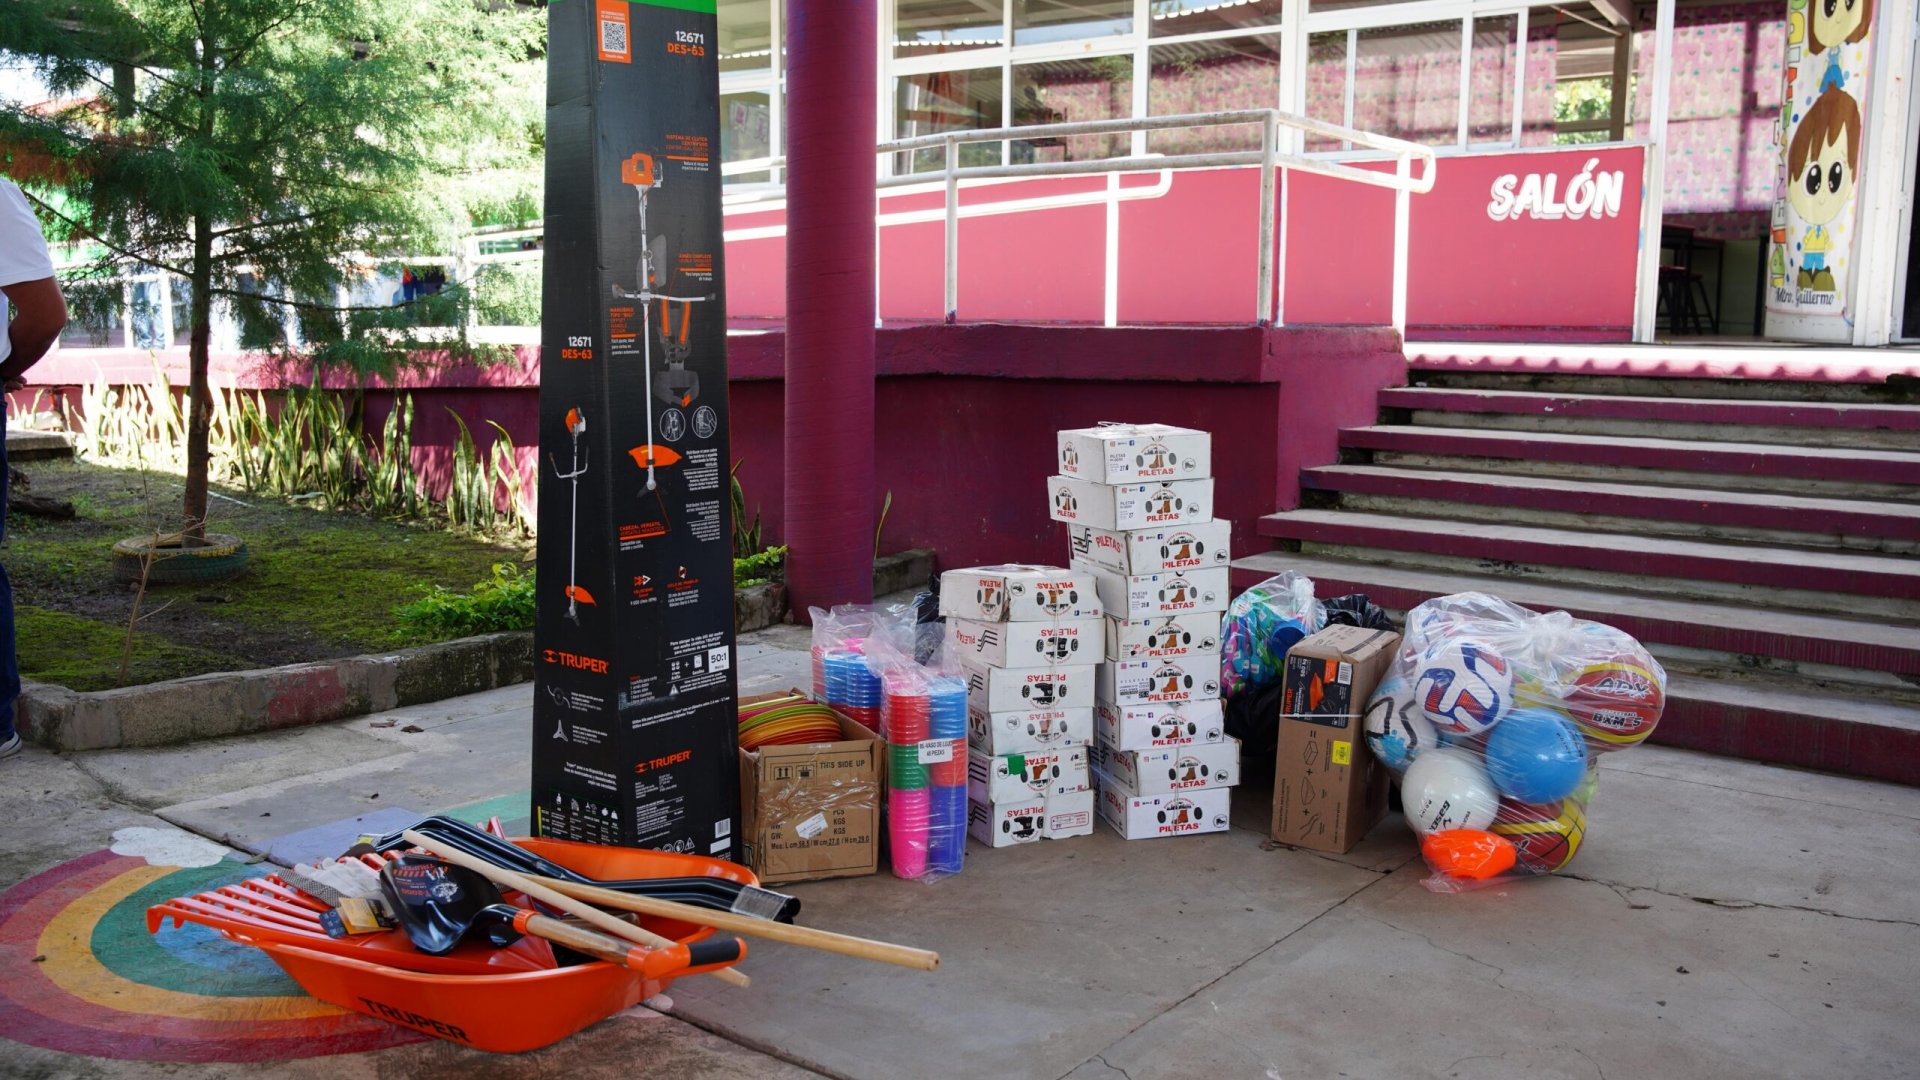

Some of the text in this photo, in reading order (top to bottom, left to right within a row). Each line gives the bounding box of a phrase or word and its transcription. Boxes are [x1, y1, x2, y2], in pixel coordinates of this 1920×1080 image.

[675, 30, 704, 45] 12671
[667, 43, 705, 57] DES-63
[1487, 157, 1624, 222] SALÓN
[1796, 287, 1835, 308] Guillermo
[568, 336, 592, 347] 12671
[562, 349, 592, 360] DES-63
[1138, 467, 1174, 477] PILETAS
[1057, 509, 1077, 519] PILETAS
[1146, 513, 1180, 522] PILETAS
[1095, 535, 1121, 553] PILETAS
[980, 579, 1002, 588] PILETAS
[1160, 601, 1195, 611] PILETAS
[956, 629, 976, 645] PILETAS
[559, 652, 608, 675] TRUPER
[711, 652, 727, 664] 50:1
[1148, 691, 1190, 702] PILETAS
[1029, 712, 1065, 720] PILETAS
[1151, 737, 1192, 746] PILETAS
[649, 750, 693, 770] TRUPER
[820, 759, 865, 769] THIS SIDE UP
[1007, 807, 1045, 818] PILETAS
[834, 818, 846, 826] KGS
[834, 827, 846, 835] KGS
[358, 996, 472, 1043] TRUPER
